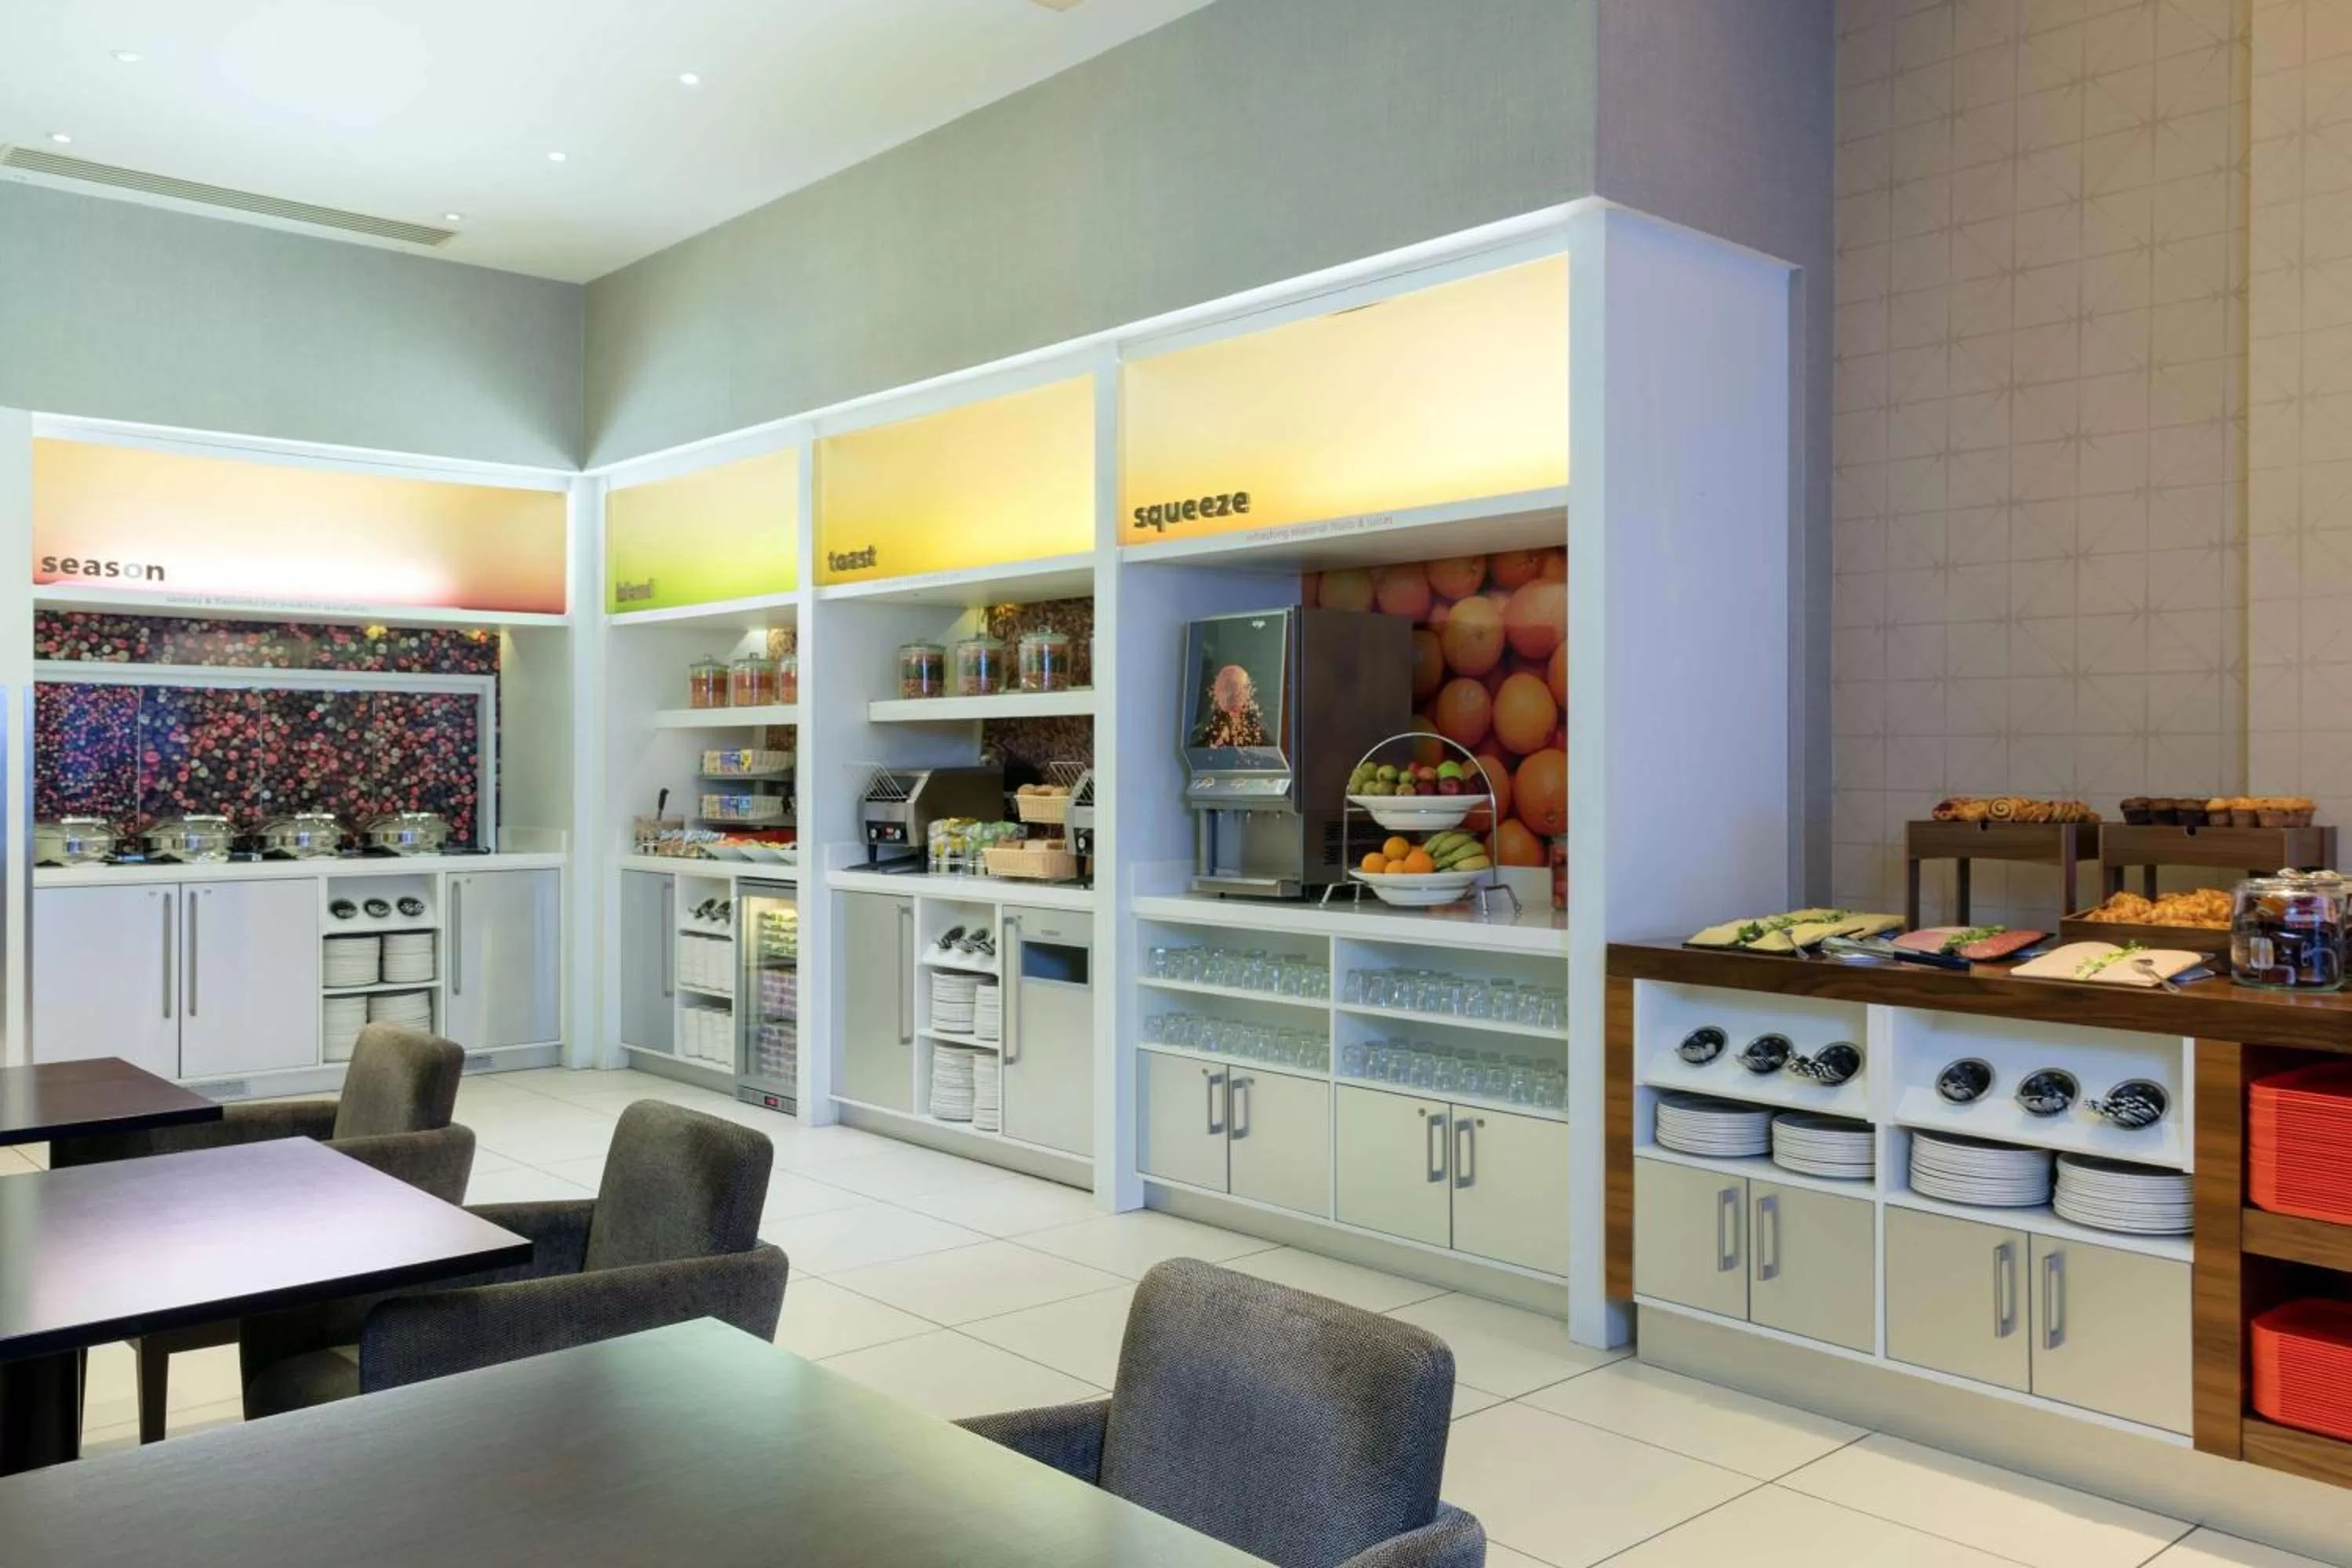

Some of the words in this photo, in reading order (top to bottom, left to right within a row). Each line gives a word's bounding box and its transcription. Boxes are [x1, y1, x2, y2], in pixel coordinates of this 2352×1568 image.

[1134, 492, 1250, 533] squeeze
[42, 556, 165, 582] season
[827, 544, 877, 572] toast
